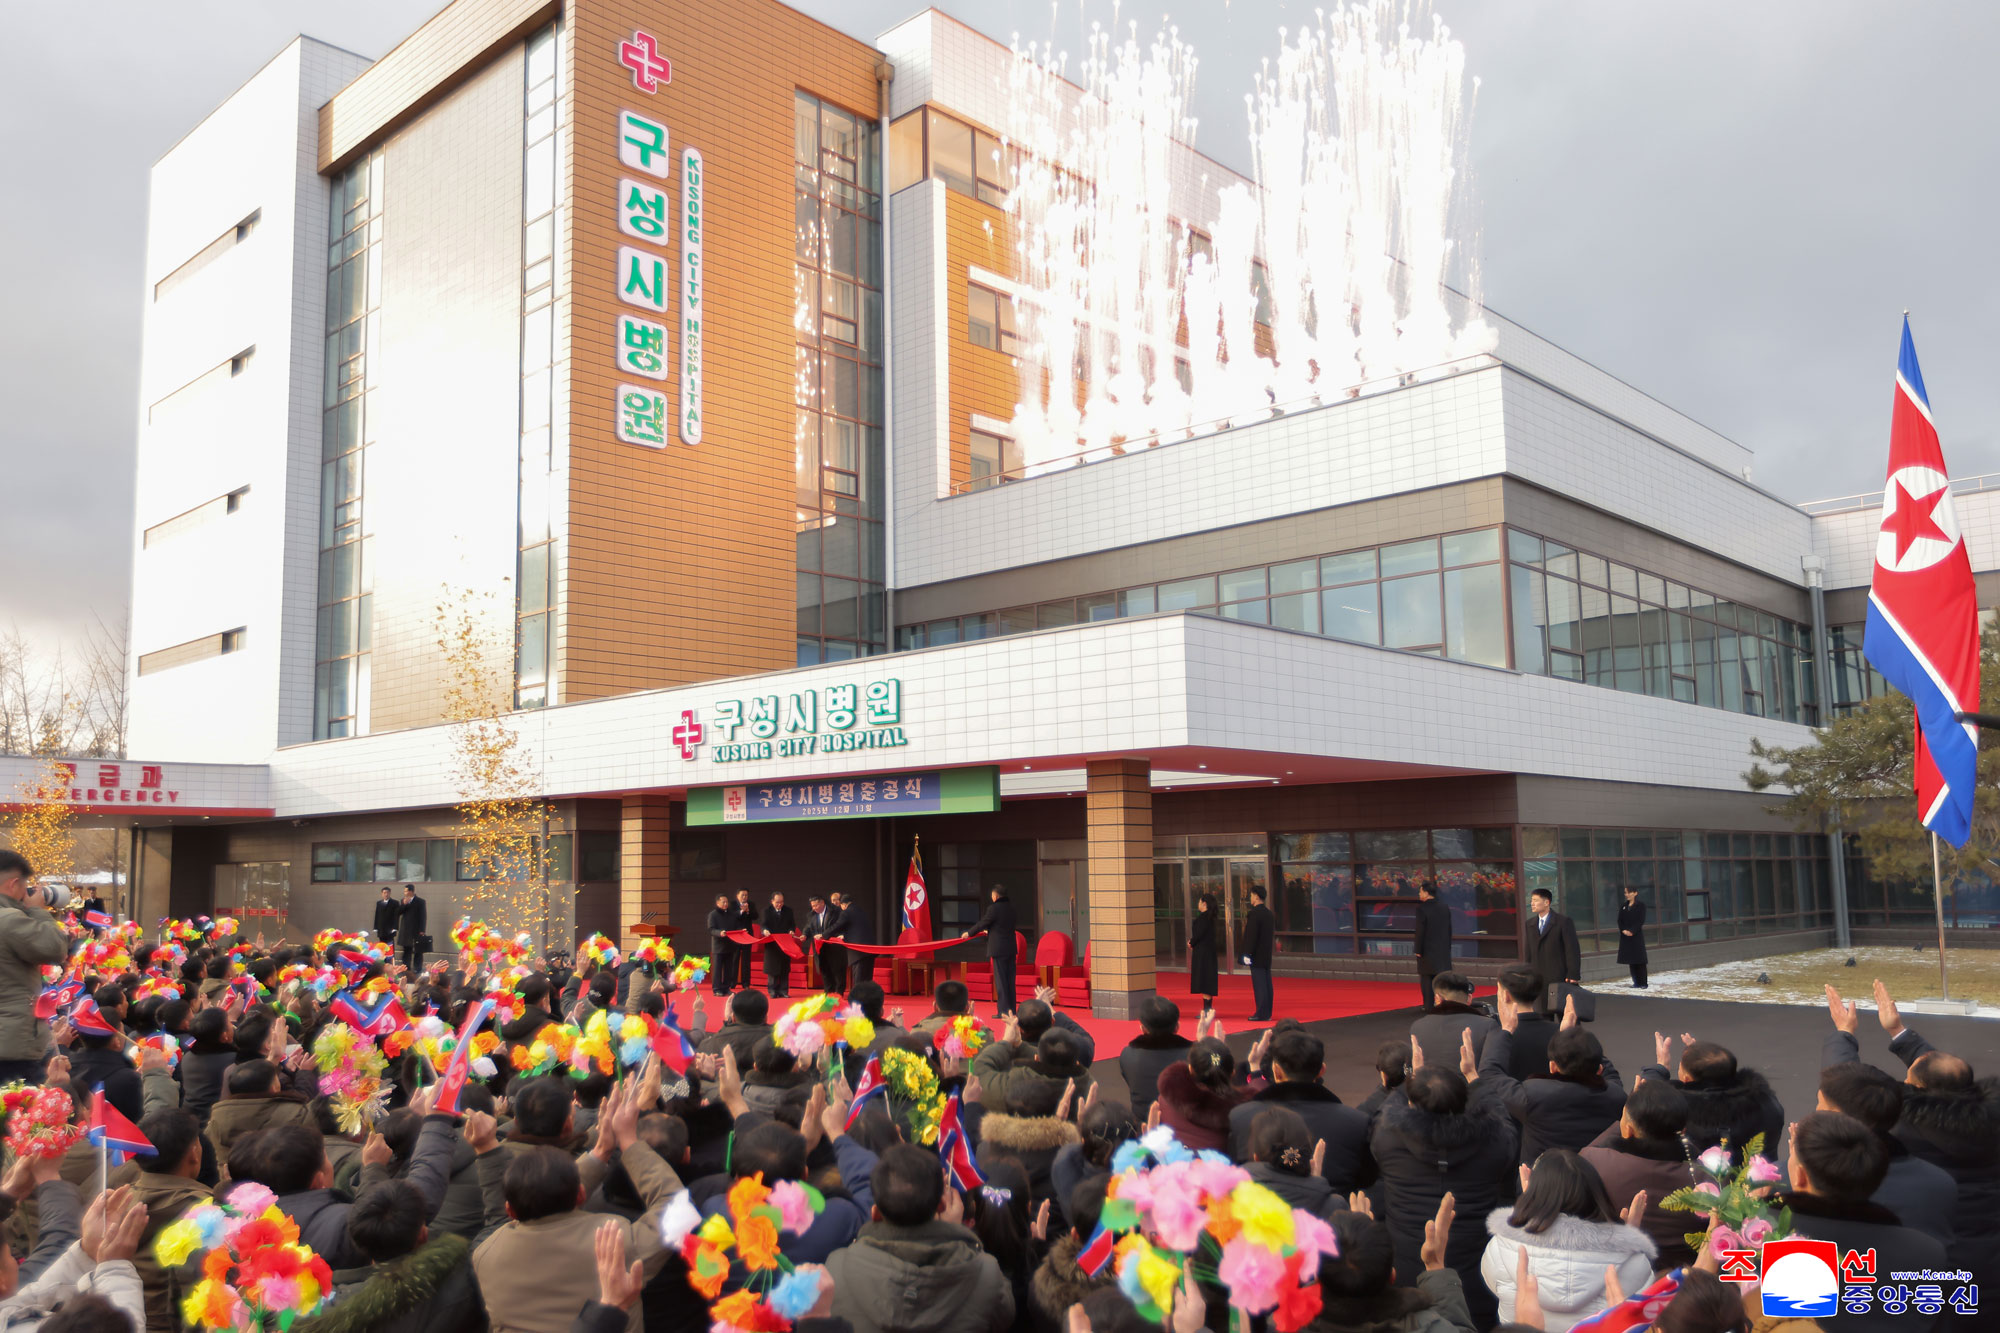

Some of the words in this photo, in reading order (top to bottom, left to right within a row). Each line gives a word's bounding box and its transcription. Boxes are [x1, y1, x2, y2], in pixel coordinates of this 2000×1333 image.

[688, 156, 699, 244] KUSONG
[623, 116, 666, 444] 구성시병원
[688, 252, 699, 309] CITY
[687, 318, 699, 436] HOSPITAL
[713, 678, 901, 741] 구성시병원
[712, 741, 772, 763] KUSONG
[776, 736, 817, 757] CITY
[820, 727, 909, 752] HOSPITAL
[759, 777, 922, 808] 구성시병원준공식
